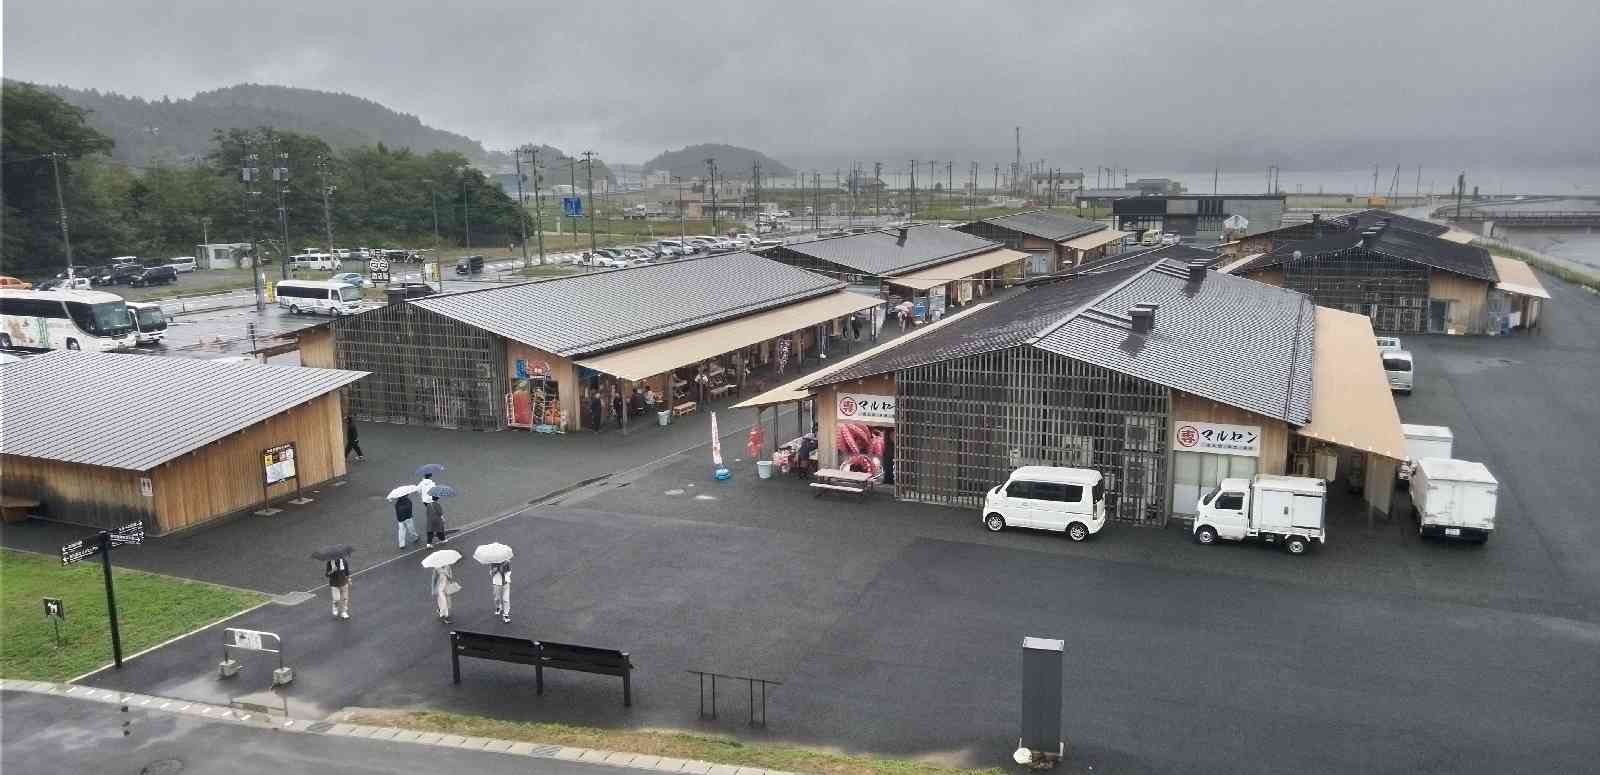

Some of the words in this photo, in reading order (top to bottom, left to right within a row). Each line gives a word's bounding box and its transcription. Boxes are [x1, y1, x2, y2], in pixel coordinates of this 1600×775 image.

[859, 400, 896, 411] マルセ
[1201, 429, 1257, 443] マルセン
